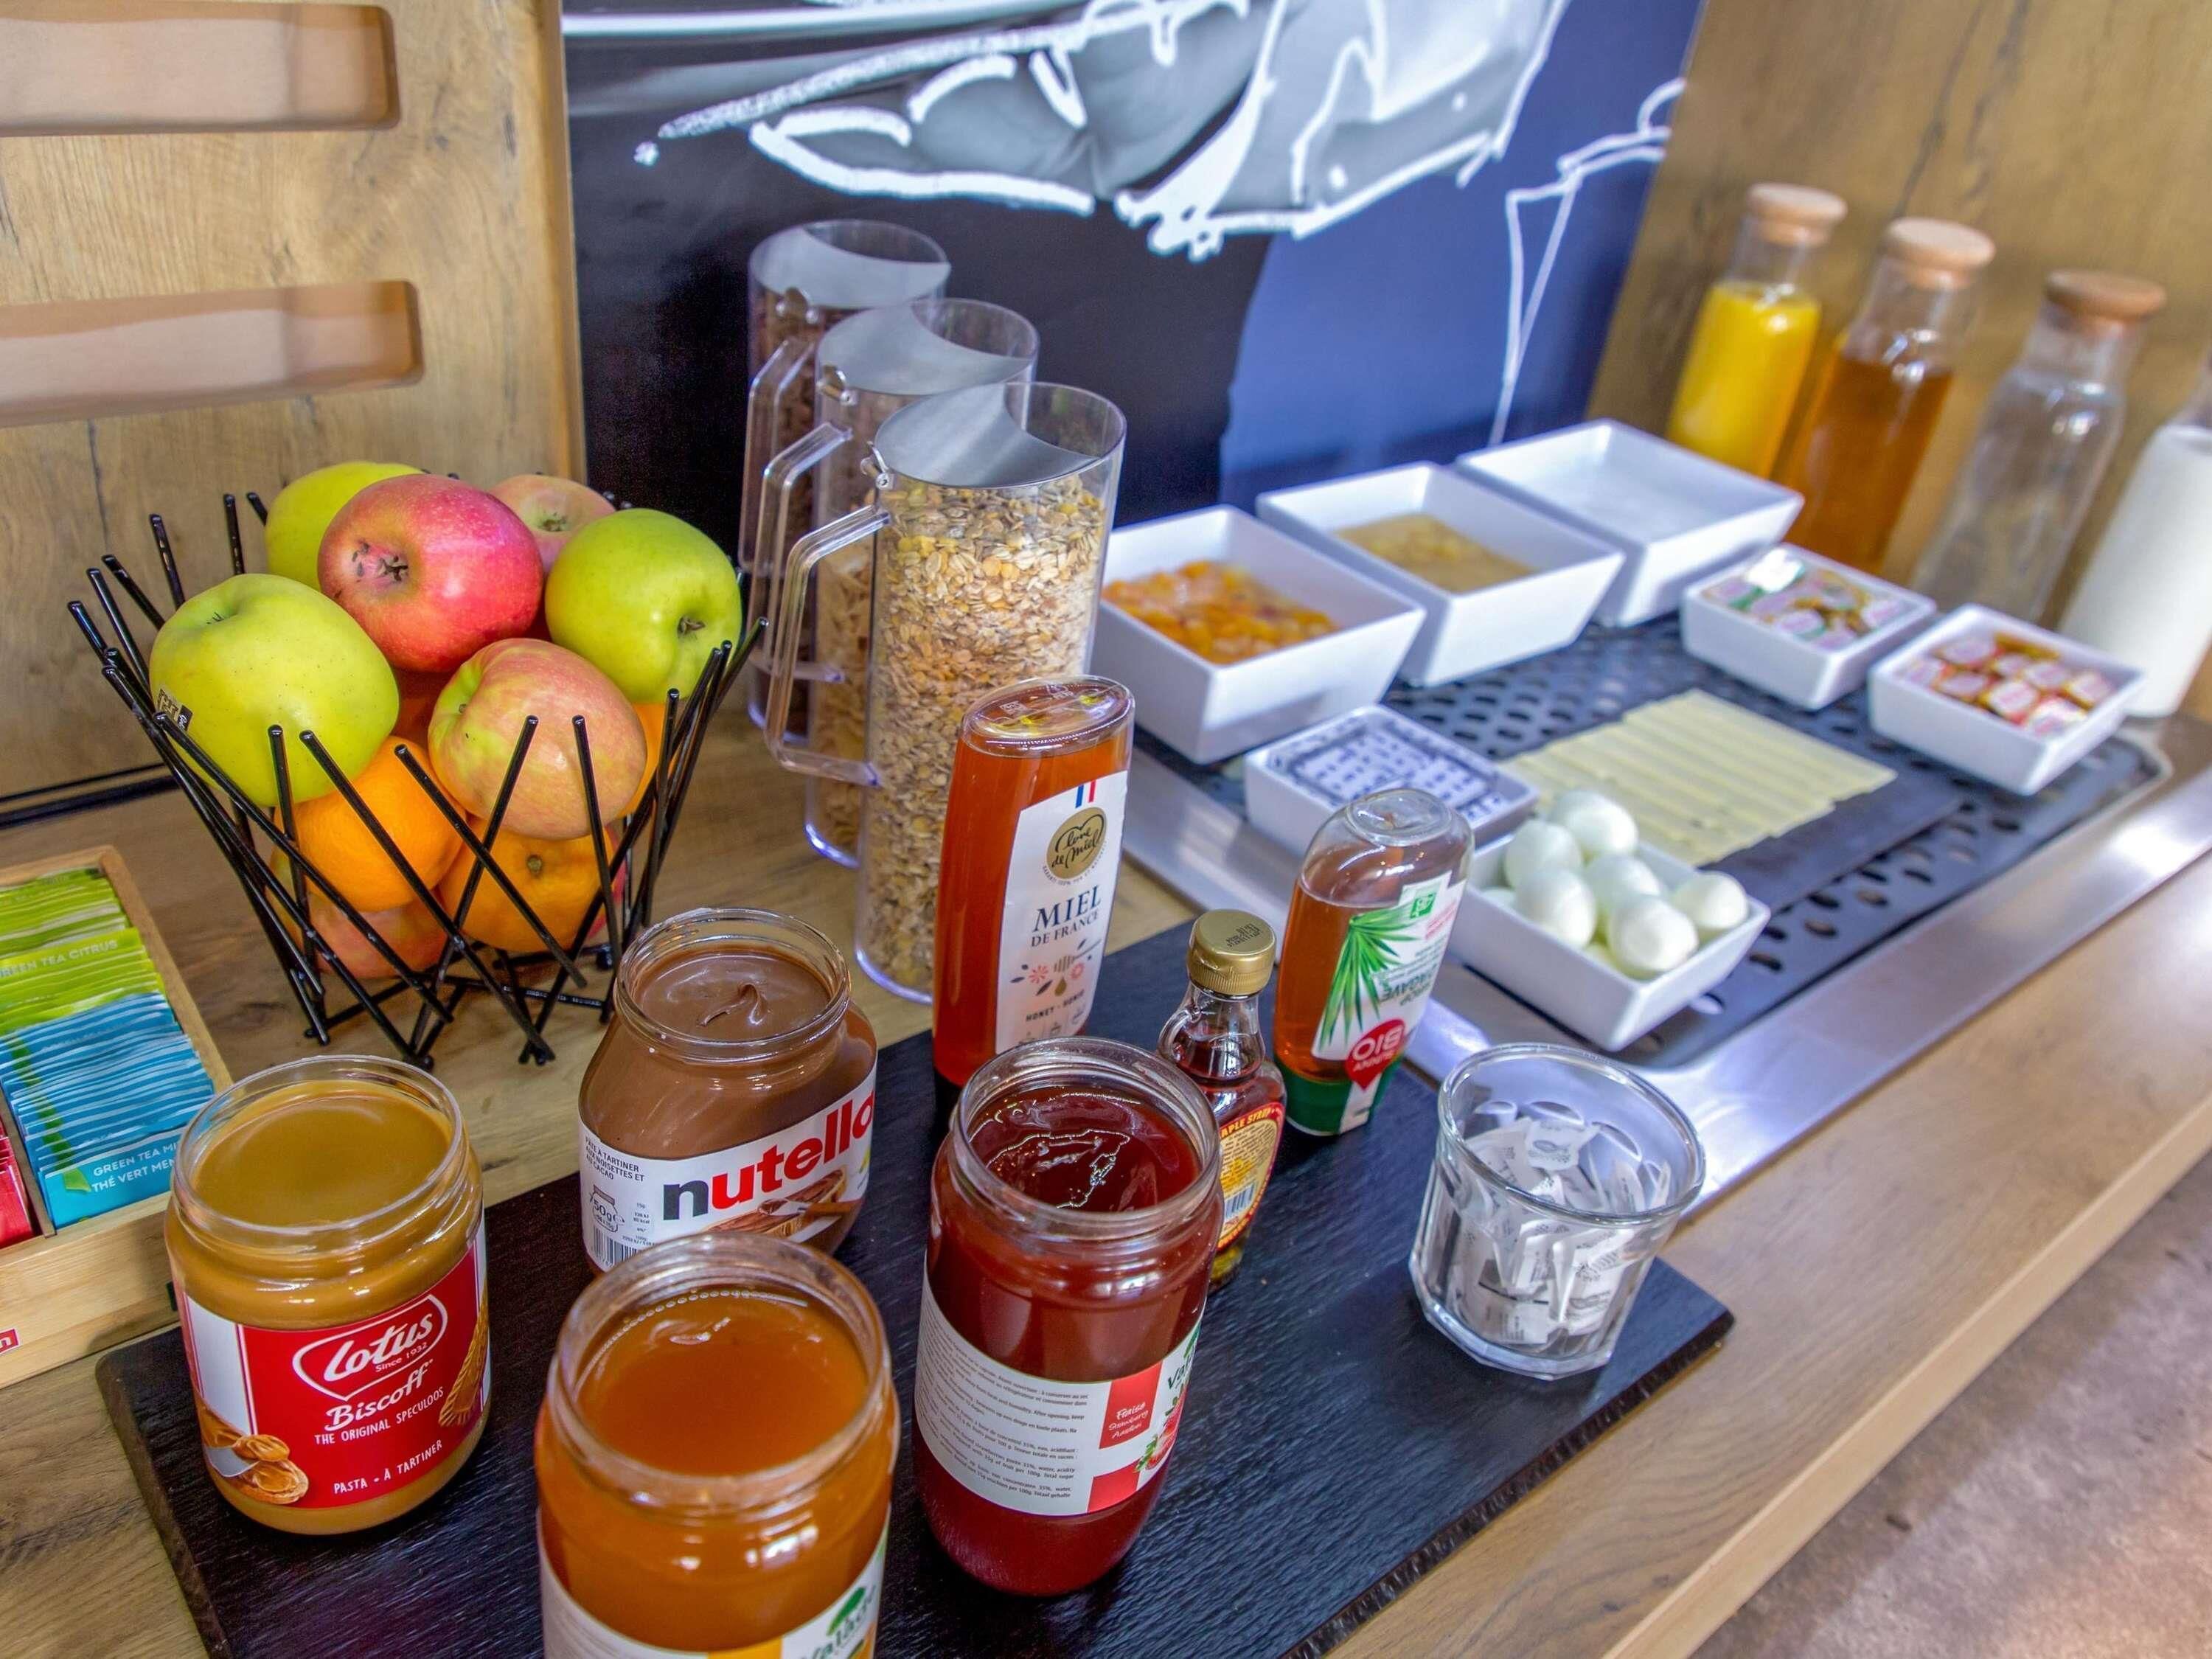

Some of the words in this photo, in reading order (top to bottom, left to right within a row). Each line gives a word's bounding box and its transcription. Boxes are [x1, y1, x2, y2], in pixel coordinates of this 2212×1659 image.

[1032, 885, 1101, 932] MIEL
[1032, 933, 1050, 947] DE
[1054, 909, 1098, 940] FRANCE
[0, 961, 37, 978] REEN
[41, 955, 66, 967] TEA
[69, 939, 118, 960] CITRUS
[1352, 1024, 1404, 1061] BIO
[1221, 1119, 1245, 1138] APLE
[93, 1156, 135, 1177] GREEN
[137, 1148, 160, 1161] TEA
[163, 1142, 177, 1153] MI
[594, 1164, 613, 1180] CACAO
[596, 1157, 633, 1179] NOISETTES
[635, 1174, 644, 1182] ET
[604, 1152, 639, 1172] TARTINER
[664, 1090, 874, 1221] nutella
[91, 1175, 116, 1192] THÉ
[118, 1166, 147, 1183] VERT
[151, 1158, 175, 1173] MEN
[324, 1314, 434, 1382] Lotus
[375, 1357, 403, 1373] Since
[406, 1341, 428, 1359] 1932
[315, 1433, 335, 1445] THE
[341, 1419, 391, 1441] ORIGINAL
[396, 1386, 444, 1425] SPECULOOS
[324, 1363, 430, 1432] Biscoff
[334, 1478, 368, 1495] PASTA
[397, 1439, 442, 1475] TARTINER
